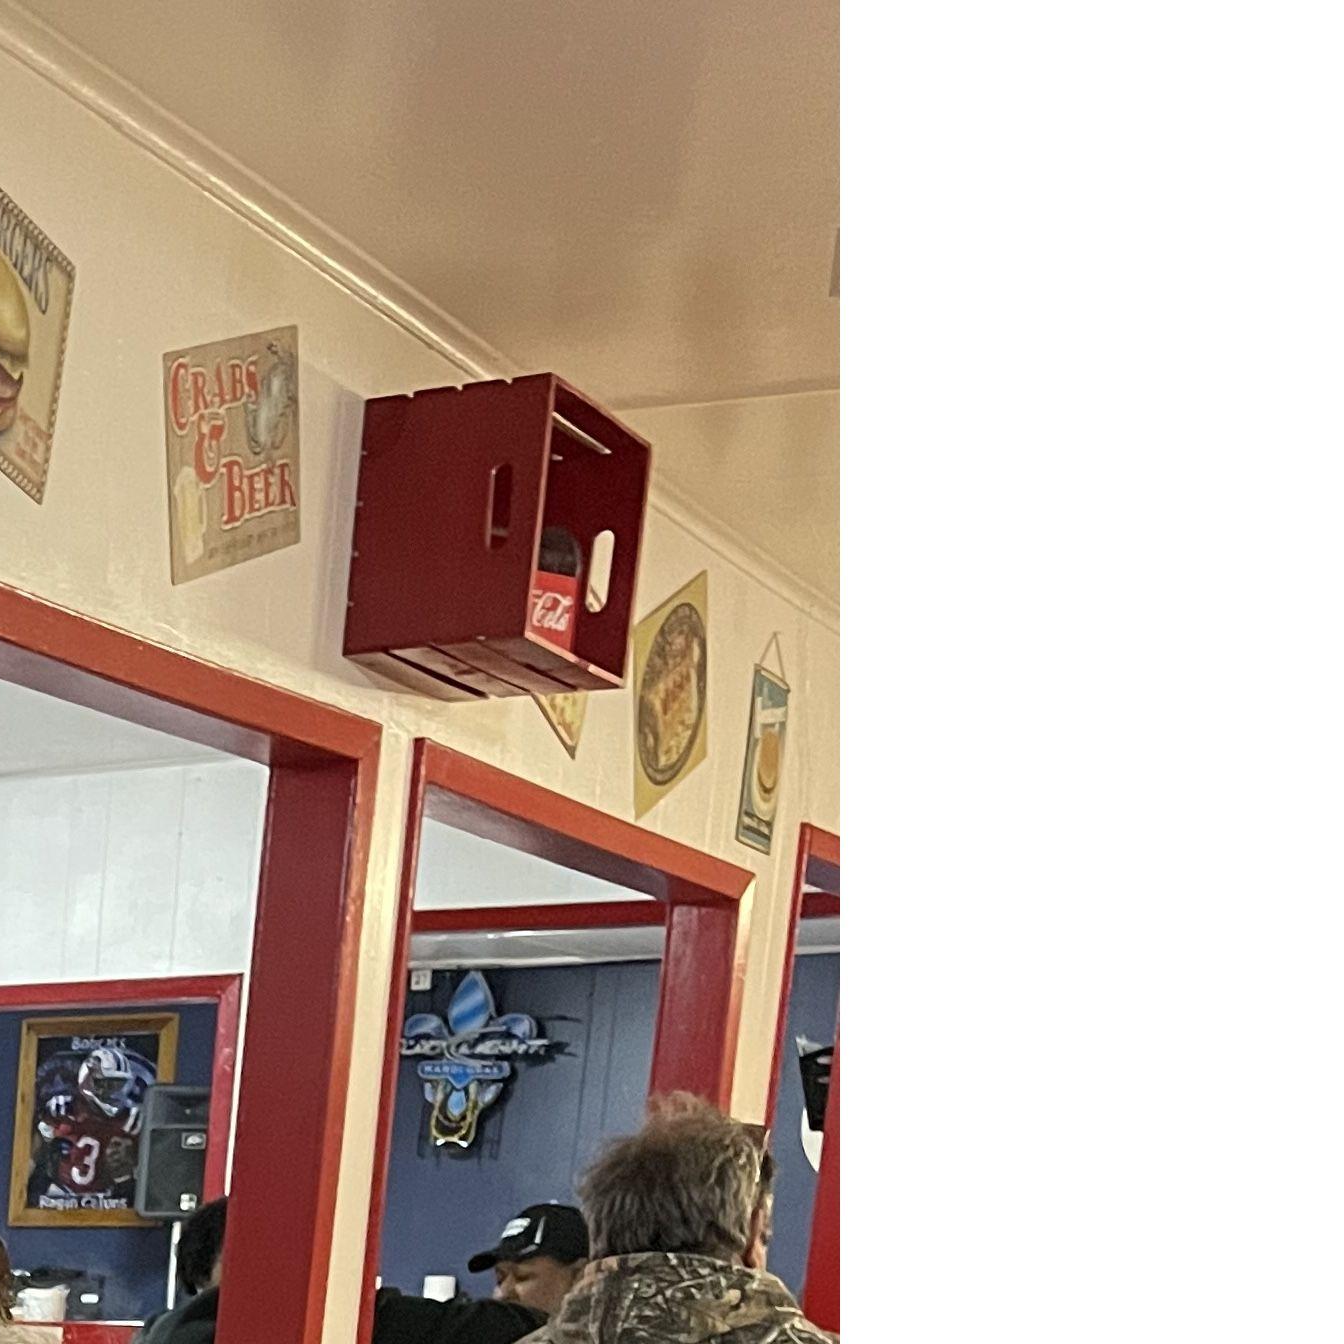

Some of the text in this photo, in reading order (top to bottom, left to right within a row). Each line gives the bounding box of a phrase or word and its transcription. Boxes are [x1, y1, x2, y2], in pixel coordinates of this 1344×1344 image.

[169, 356, 260, 434] CRABS
[194, 410, 226, 488] &
[220, 456, 297, 532] BEER
[72, 1136, 100, 1185] 3
